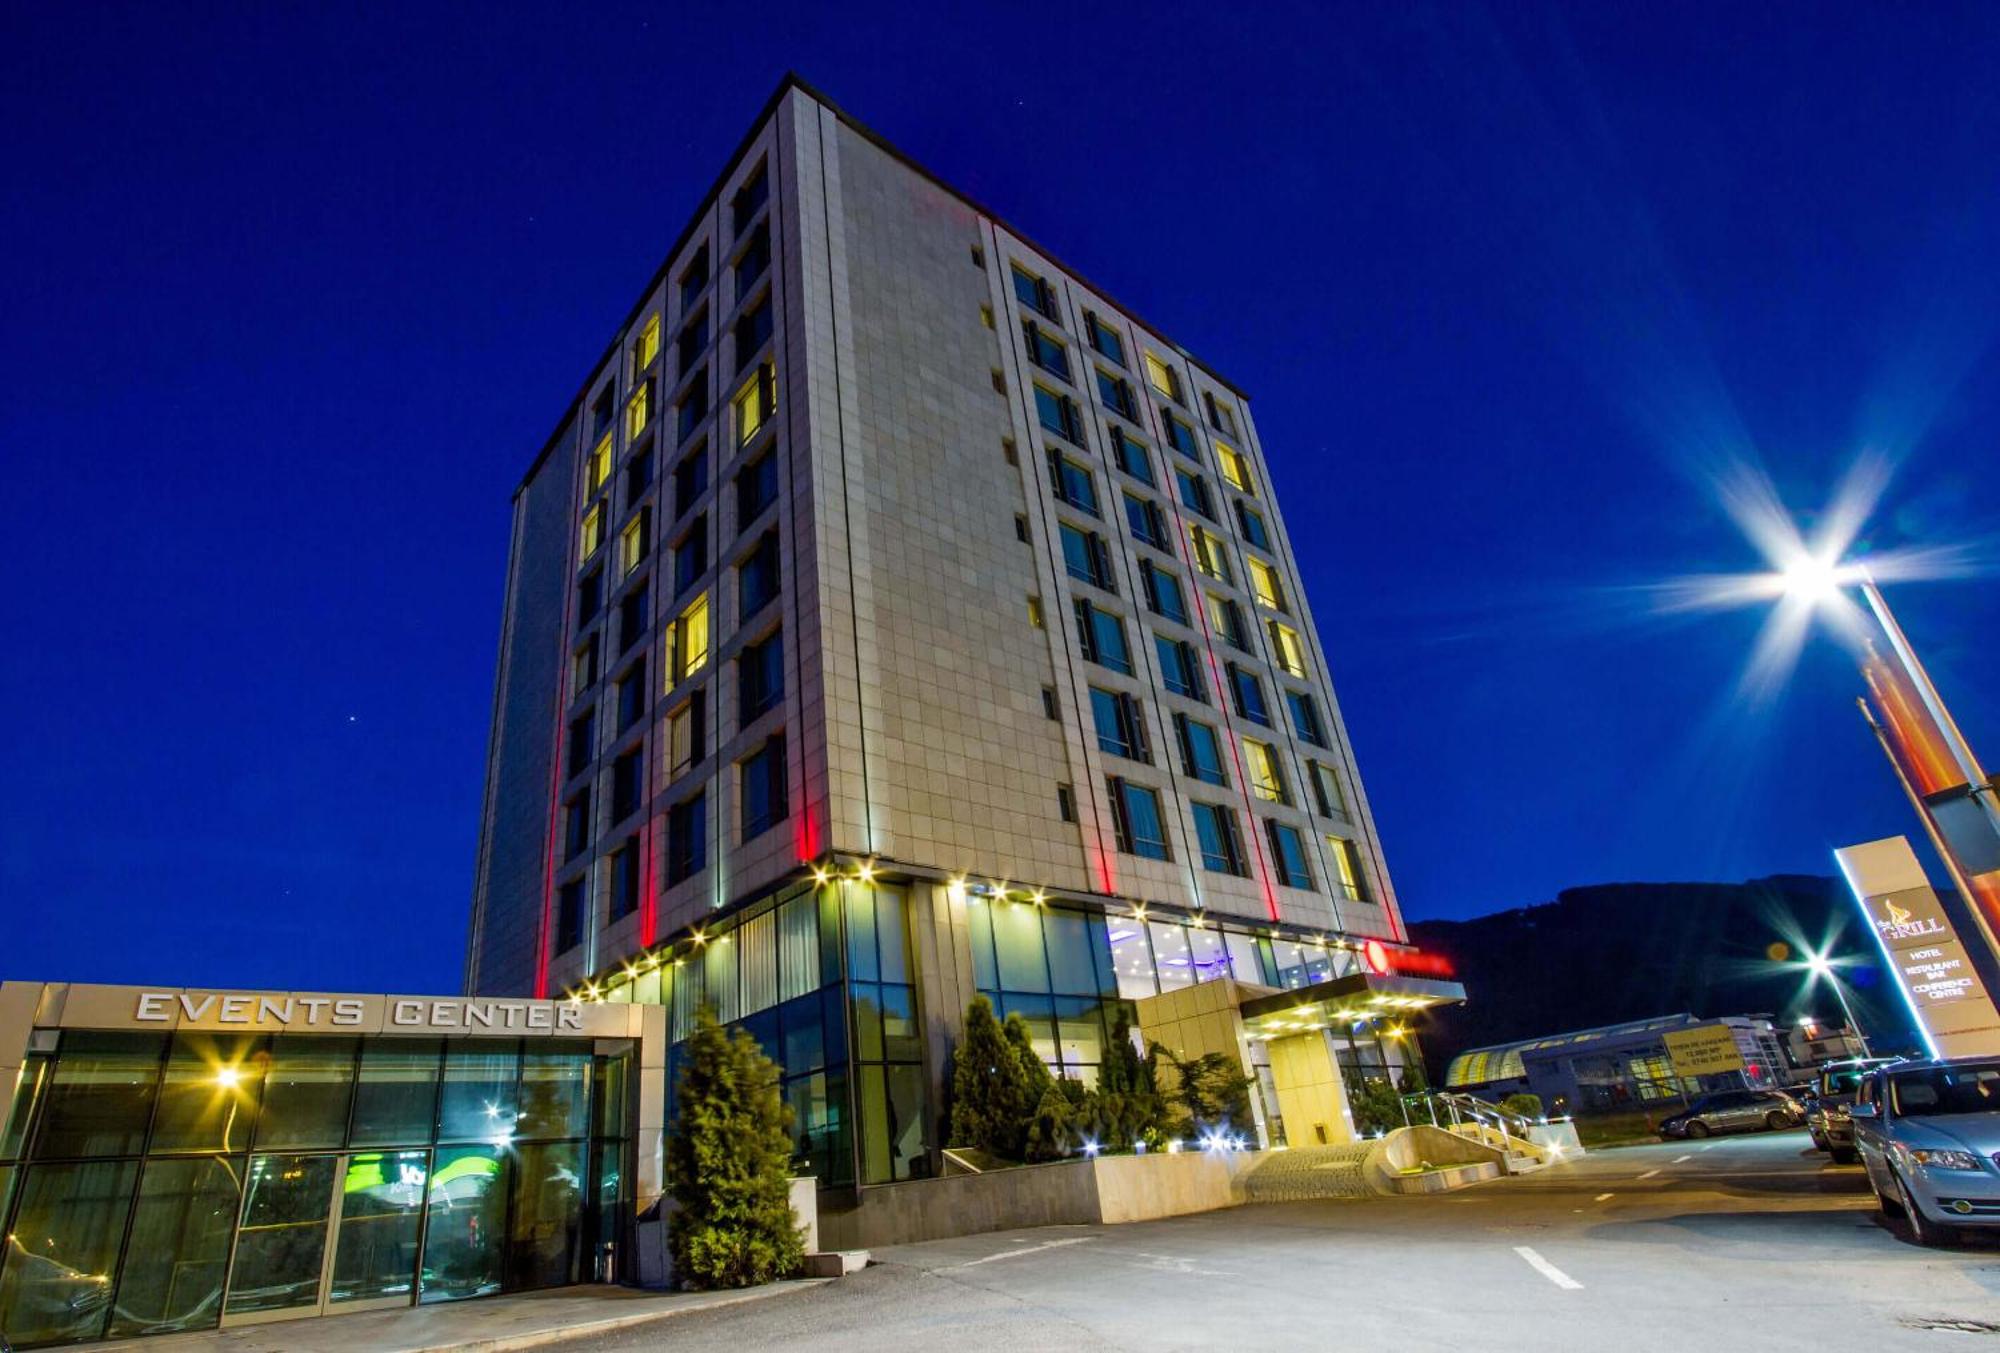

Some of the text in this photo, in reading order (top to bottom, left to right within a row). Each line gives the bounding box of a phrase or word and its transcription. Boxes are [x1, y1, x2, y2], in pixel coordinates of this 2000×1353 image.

[1910, 949, 1942, 960] HOTEL
[1905, 960, 1960, 975] RESTAURANT
[1912, 978, 1973, 993] CONFERENCE
[137, 993, 582, 1029] EVENTS CENTER
